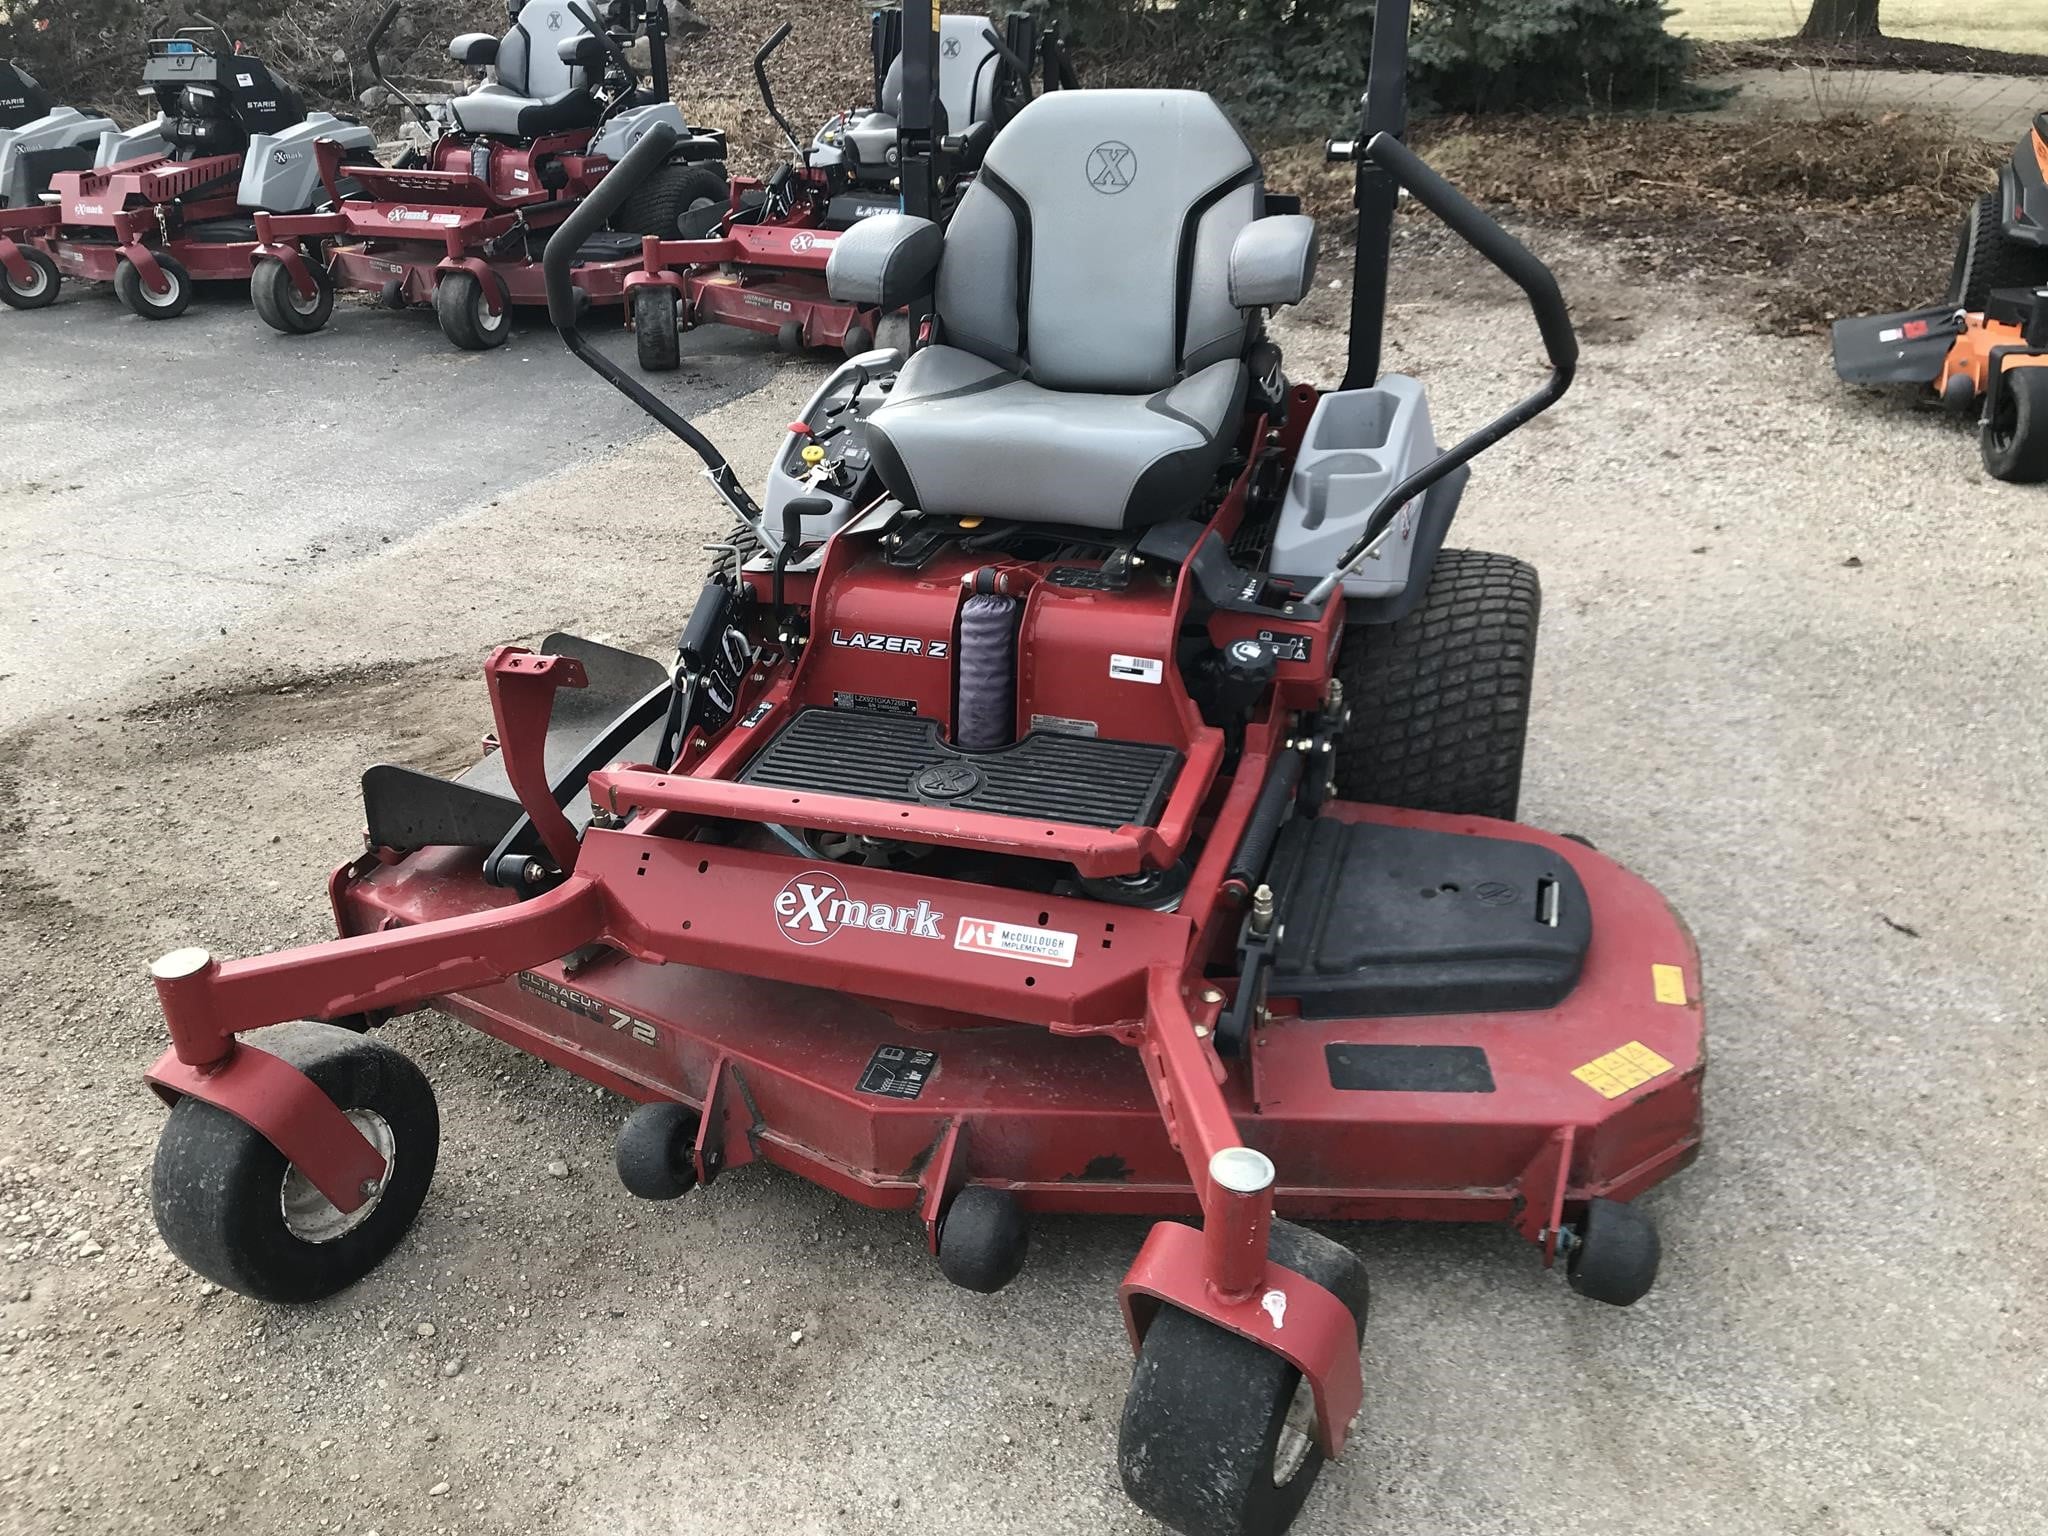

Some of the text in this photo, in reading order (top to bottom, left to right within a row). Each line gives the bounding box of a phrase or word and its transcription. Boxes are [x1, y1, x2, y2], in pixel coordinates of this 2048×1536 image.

[246, 100, 277, 109] STARIS
[1093, 146, 1131, 188] X
[773, 300, 792, 312] 60
[831, 630, 949, 659] LAZER Z
[775, 882, 944, 940] eXmark
[1001, 940, 1046, 954] IMPLEMENT
[520, 971, 657, 1048] ULTRACUT 72
